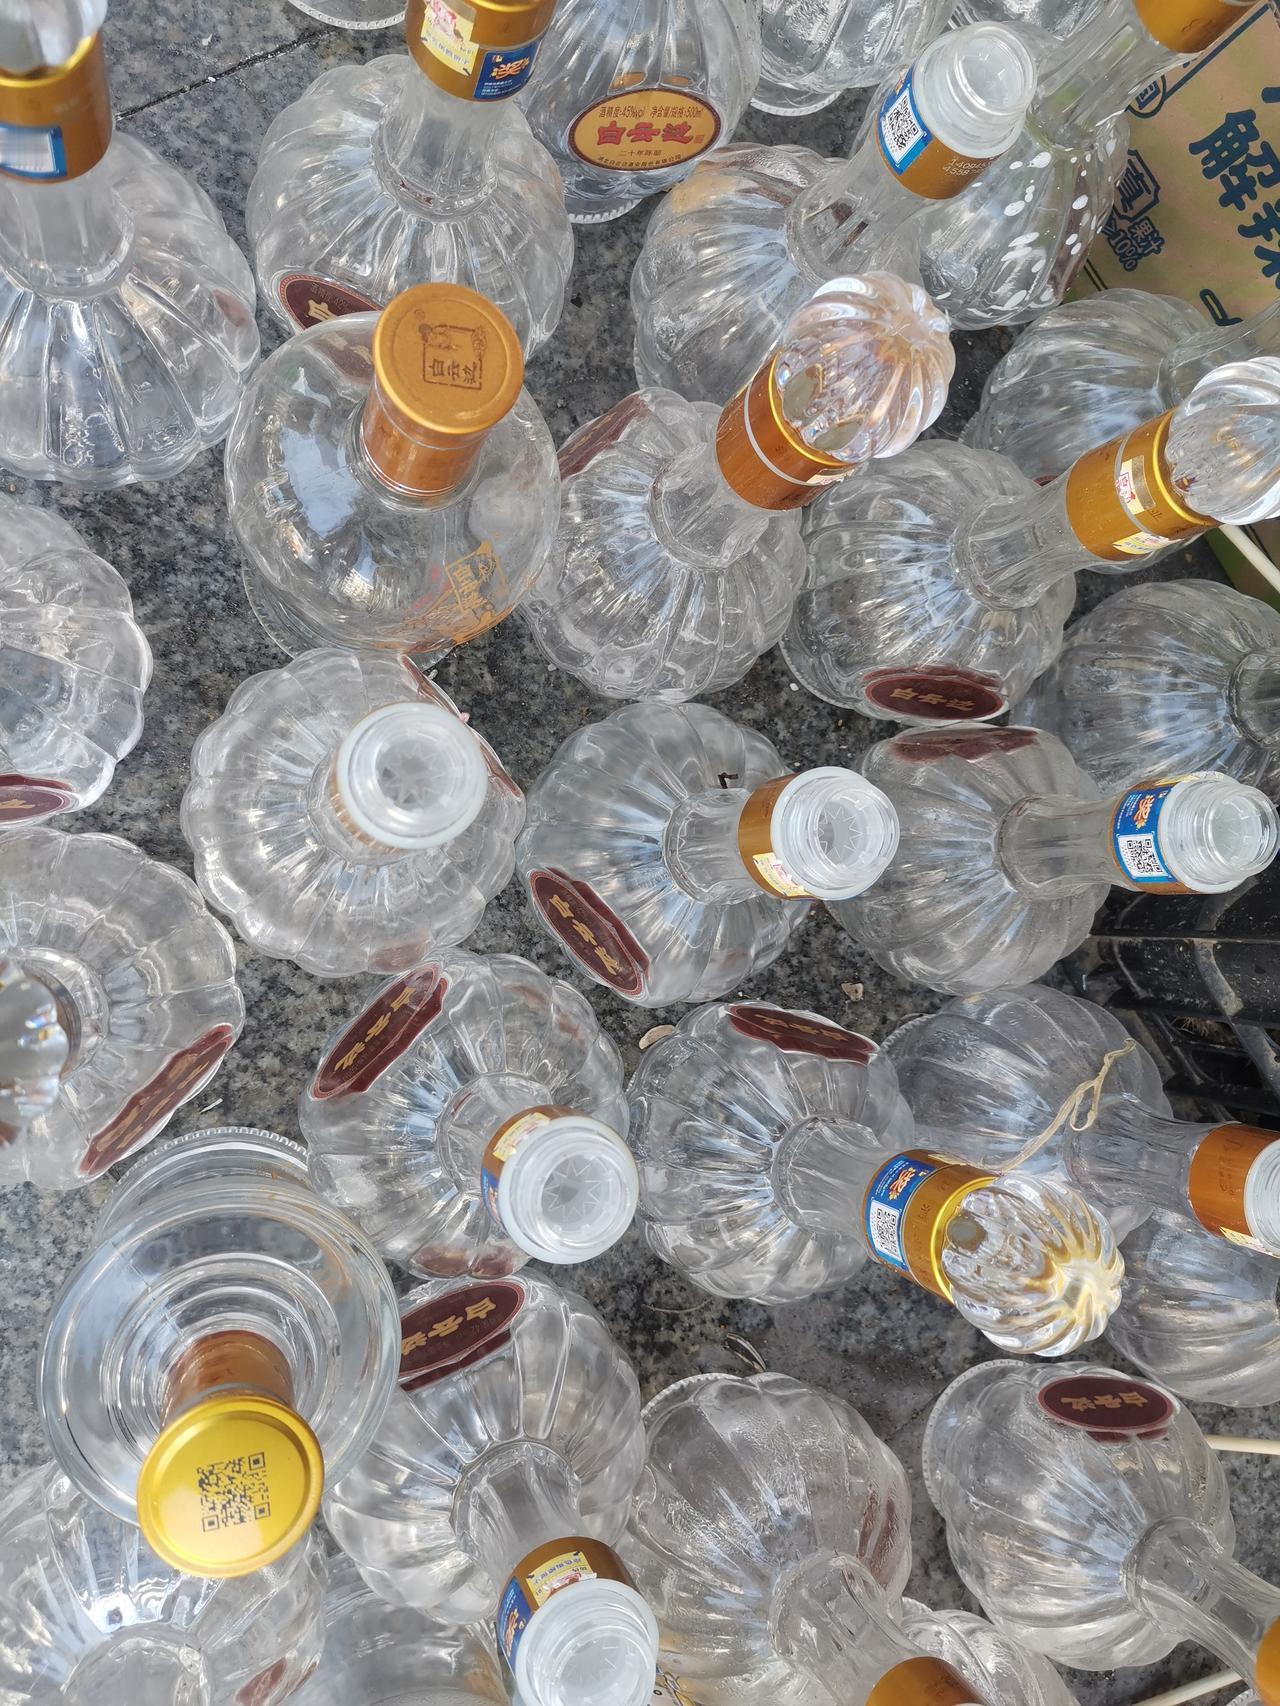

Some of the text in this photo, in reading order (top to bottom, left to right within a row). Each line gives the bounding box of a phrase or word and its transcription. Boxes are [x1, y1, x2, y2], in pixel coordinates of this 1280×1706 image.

[597, 120, 694, 146] 白云边
[1129, 217, 1164, 257] 果汁
[889, 688, 976, 712] 白云边
[549, 894, 621, 976] 白云边
[333, 986, 417, 1073] 白云边
